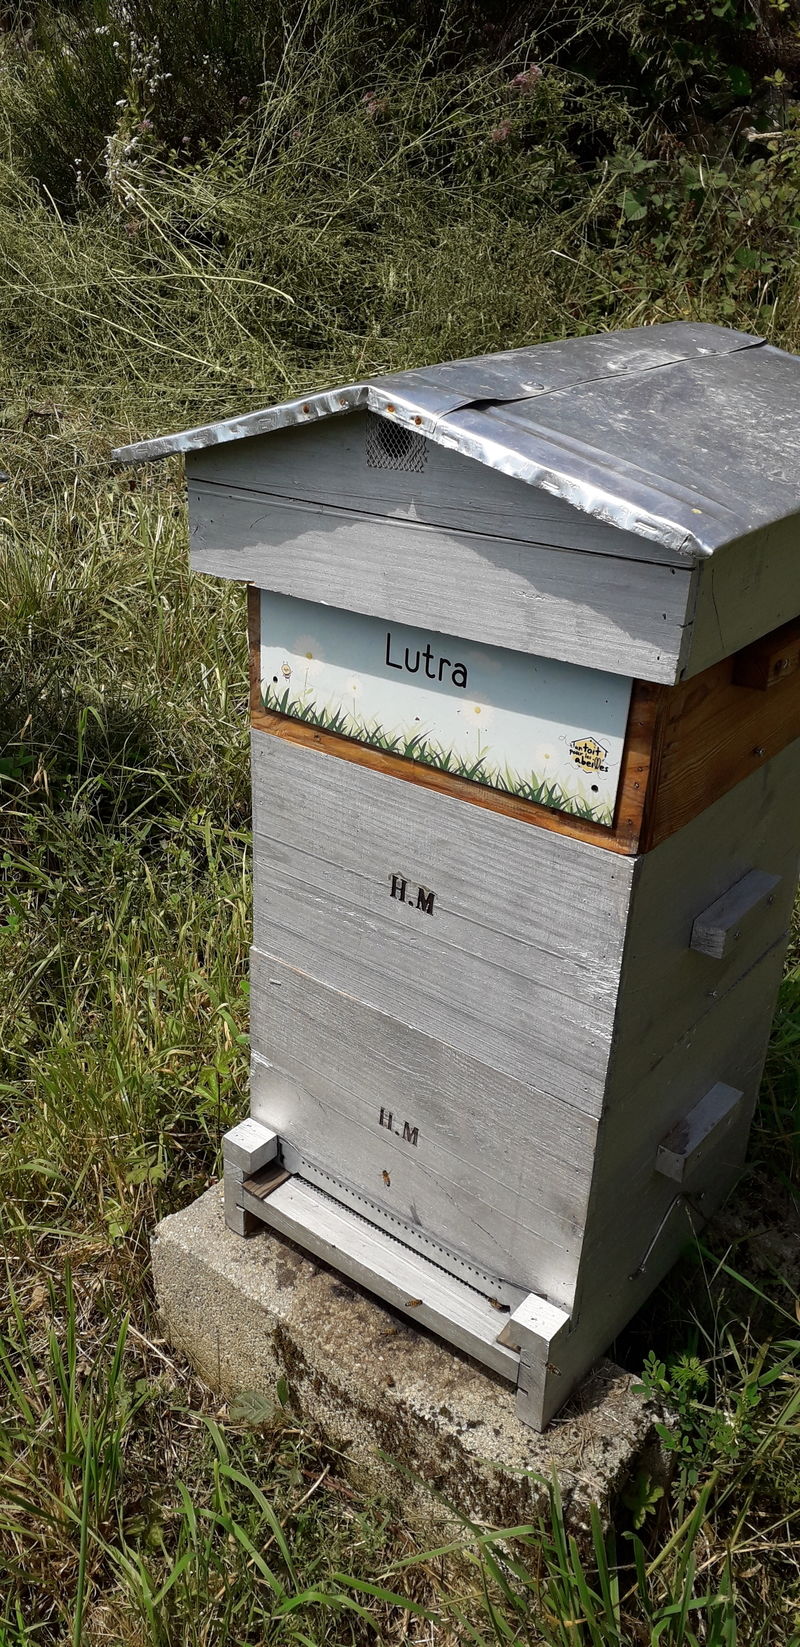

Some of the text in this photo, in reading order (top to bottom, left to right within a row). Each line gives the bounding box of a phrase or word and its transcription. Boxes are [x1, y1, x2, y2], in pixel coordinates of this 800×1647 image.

[386, 632, 468, 689] Lutra
[575, 755, 609, 772] abeilles
[583, 743, 601, 756] toit
[389, 875, 435, 917] H.M
[379, 1106, 419, 1148] H.M
